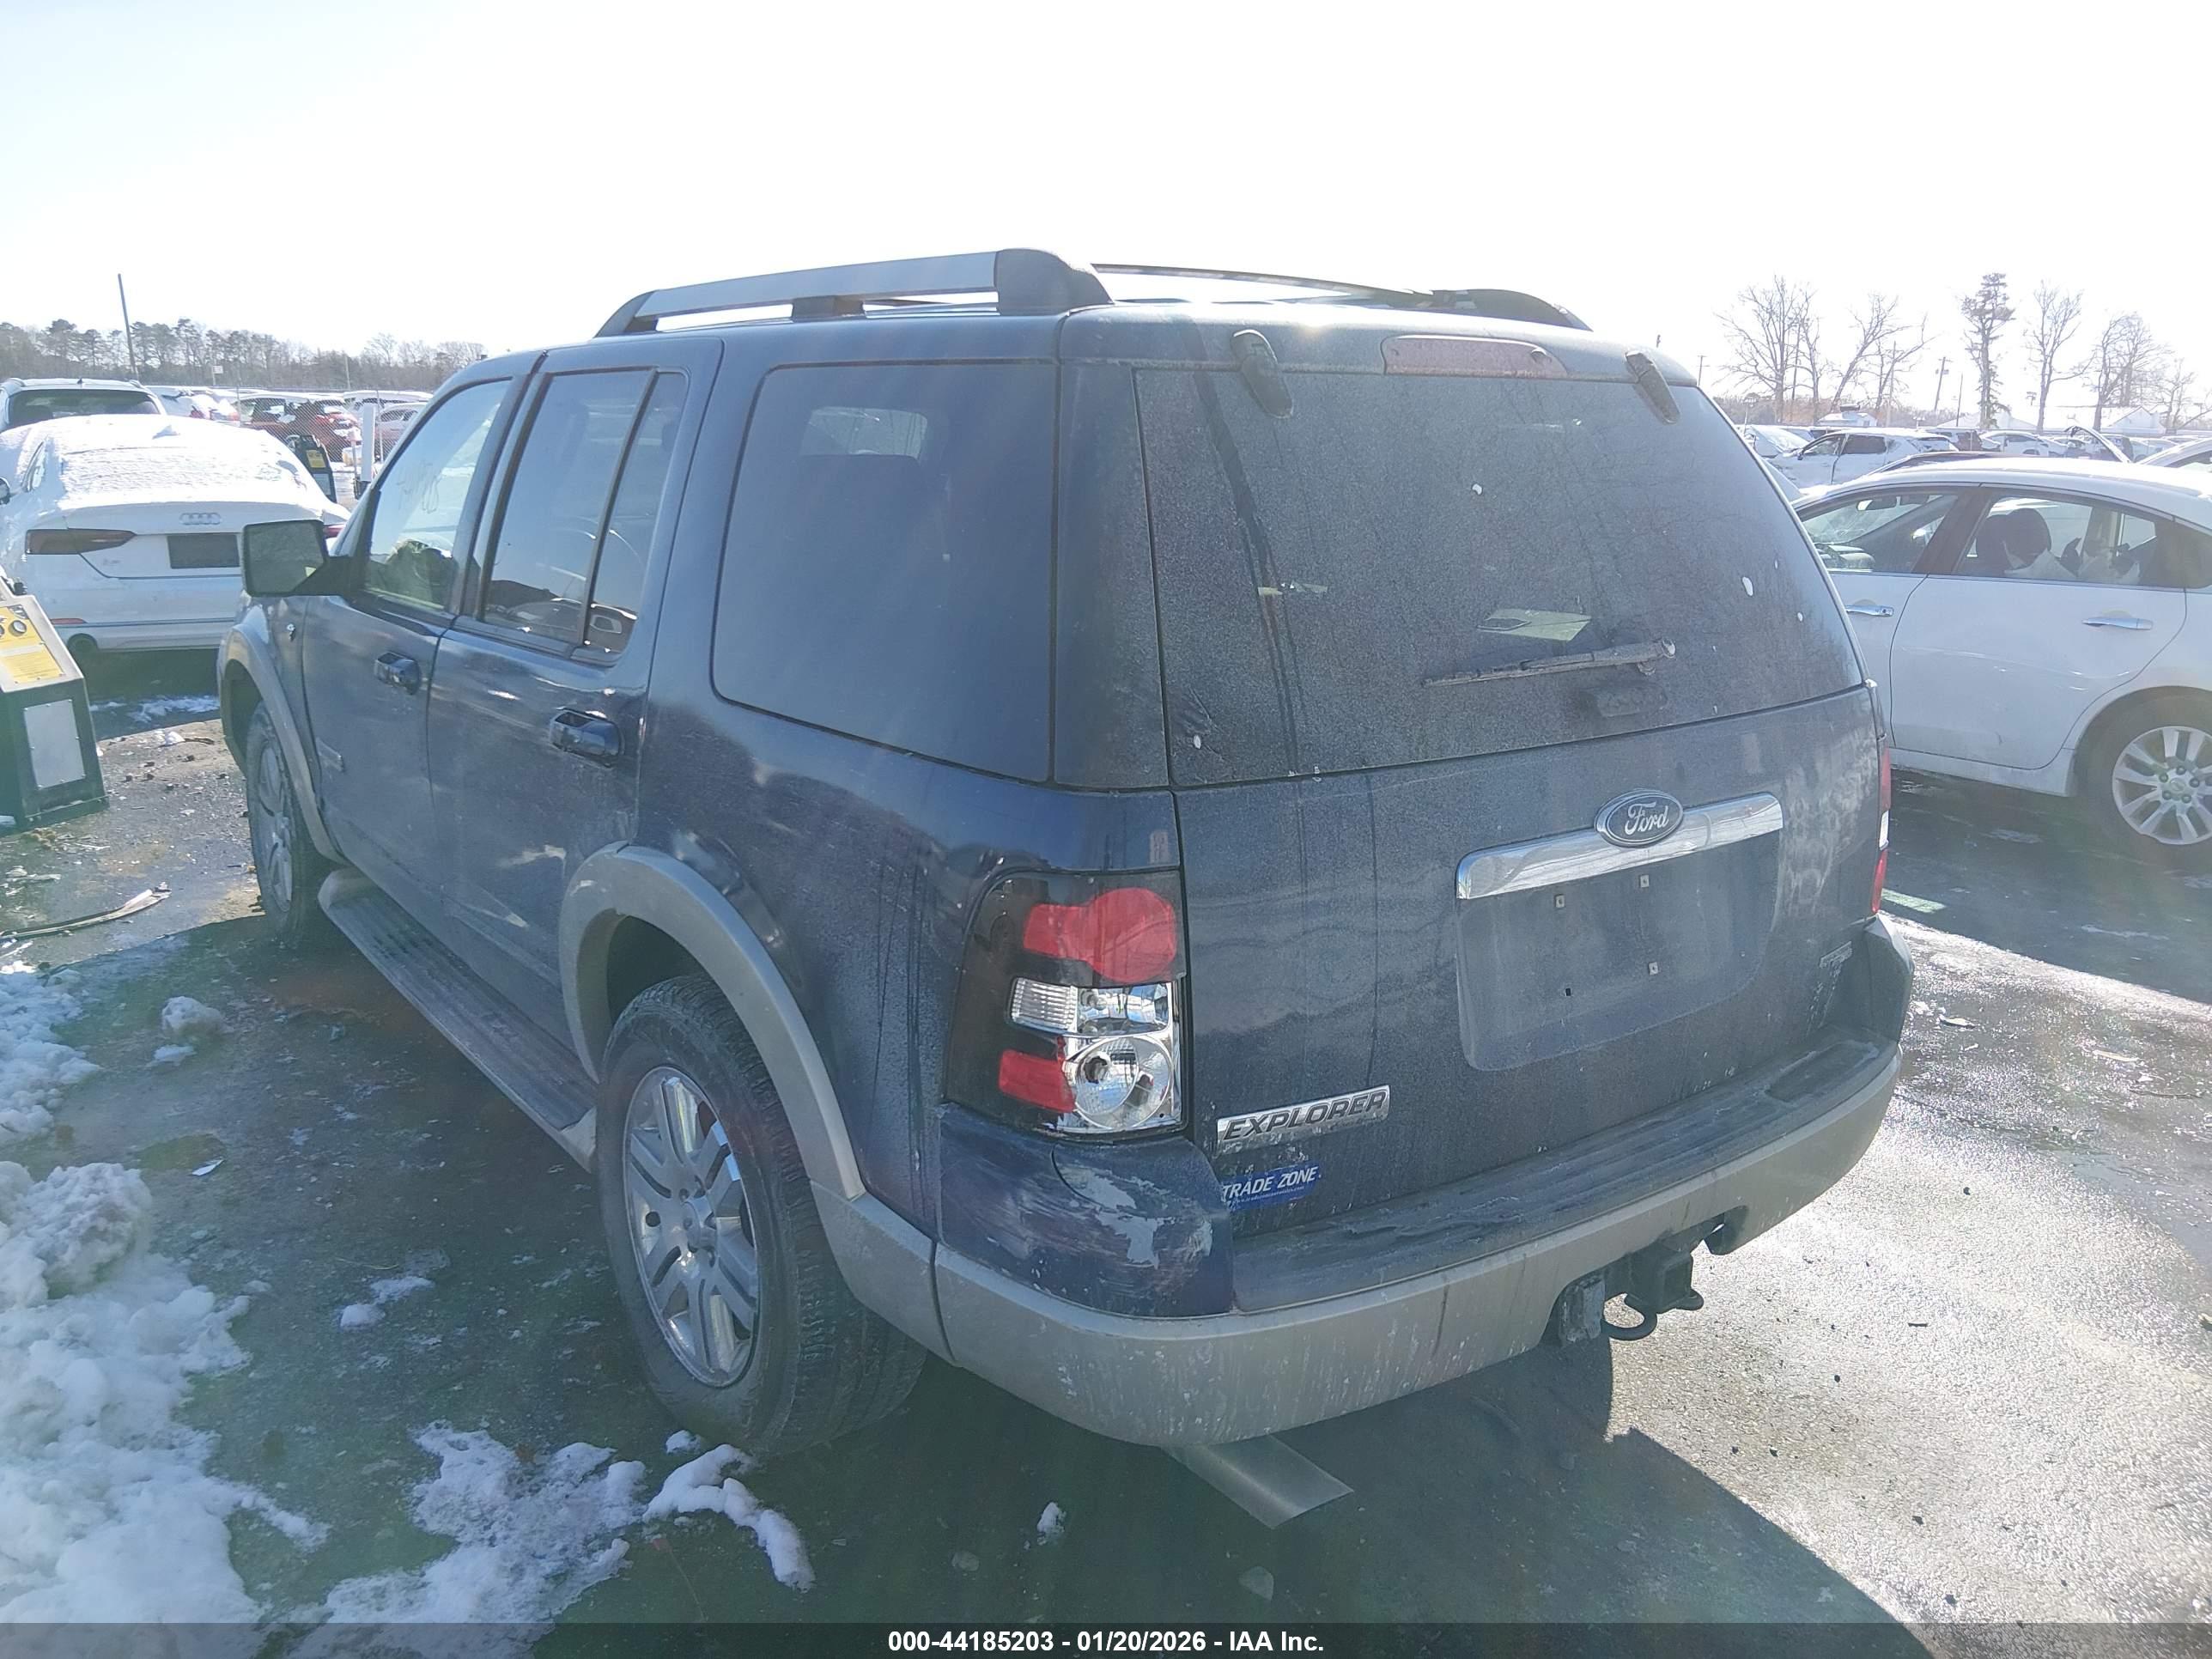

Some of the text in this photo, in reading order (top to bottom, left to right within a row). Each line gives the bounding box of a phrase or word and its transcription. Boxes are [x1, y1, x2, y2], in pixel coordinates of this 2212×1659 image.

[1625, 800, 1669, 836] Ford
[1223, 1090, 1388, 1140] EXPLORER
[1222, 1176, 1274, 1200] TRADE
[1277, 1166, 1318, 1188] ZONE
